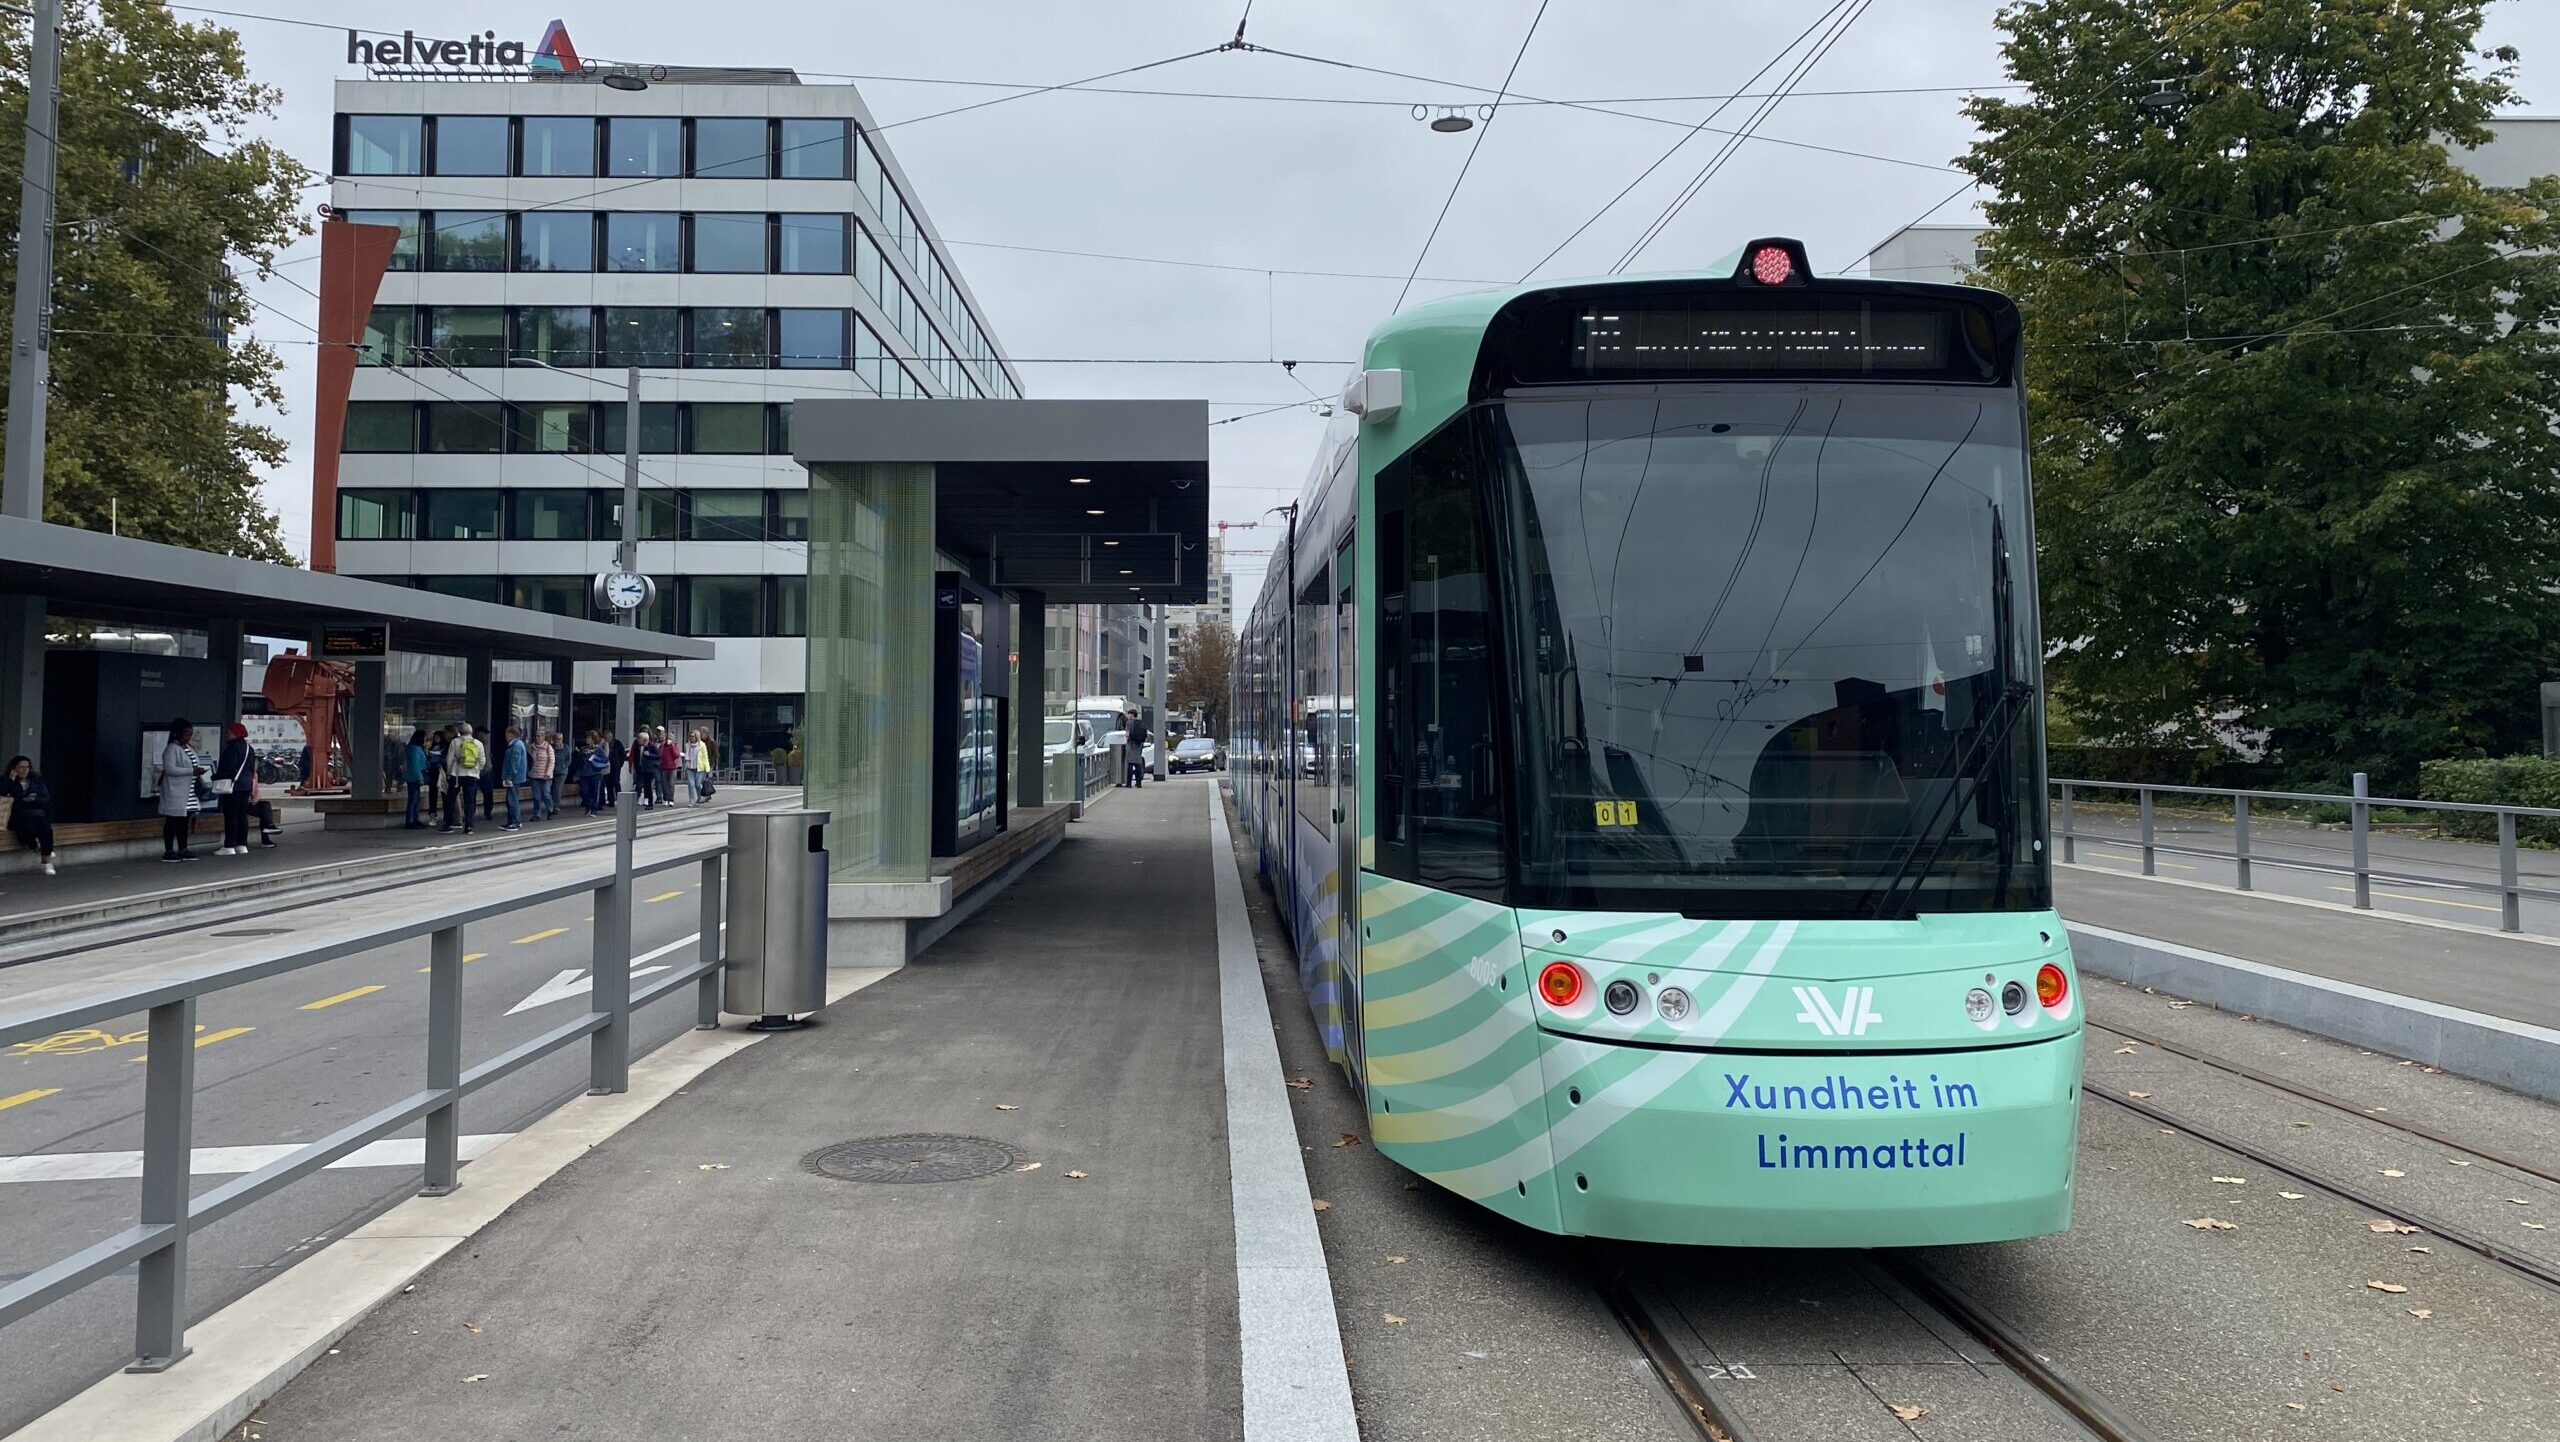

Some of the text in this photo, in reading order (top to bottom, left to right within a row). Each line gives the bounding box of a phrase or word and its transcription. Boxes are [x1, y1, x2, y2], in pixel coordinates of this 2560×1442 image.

[347, 29, 524, 66] helvetia
[1470, 955, 1498, 987] 8005
[1724, 1074, 1978, 1110] Xundheit im
[1758, 1132, 1965, 1169] Limmattal
